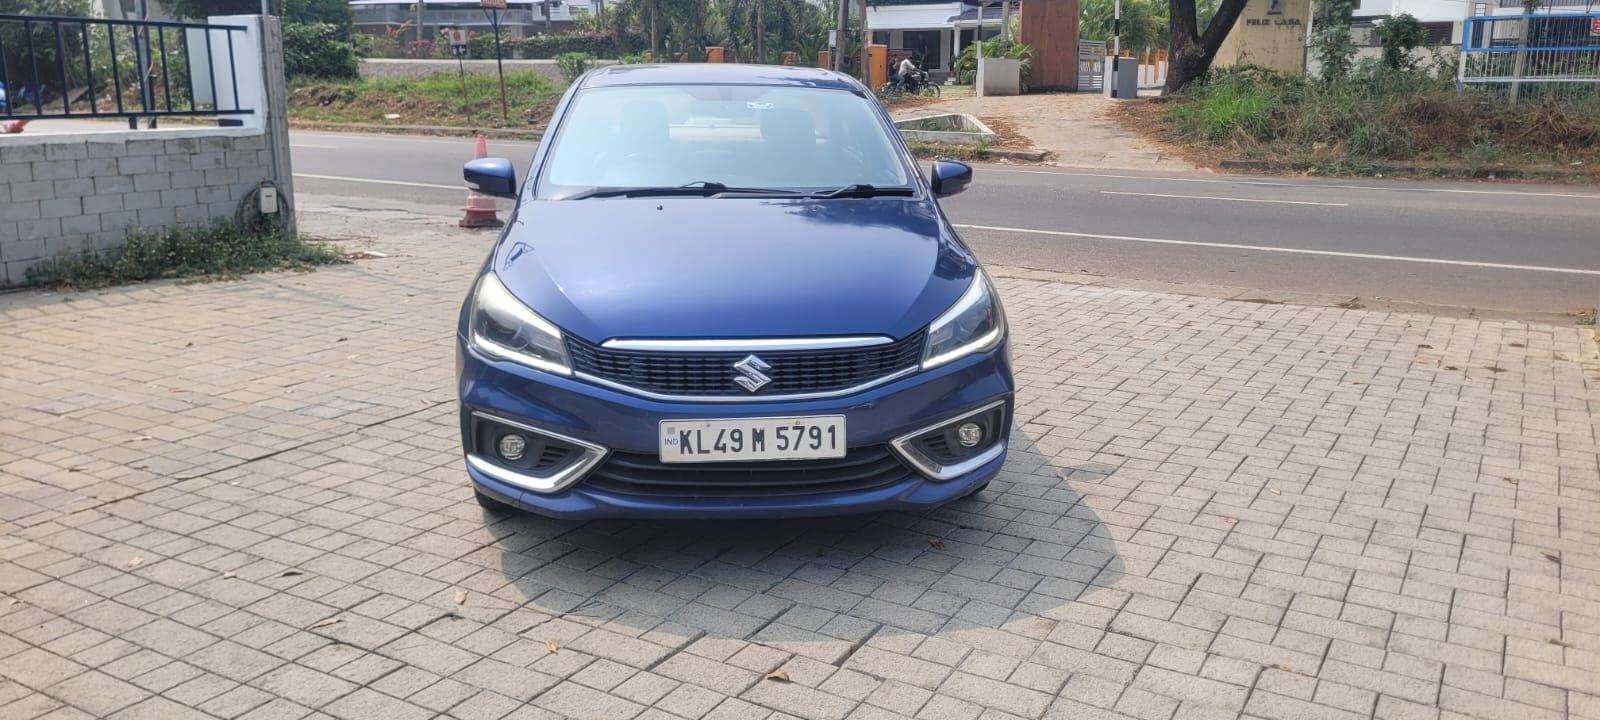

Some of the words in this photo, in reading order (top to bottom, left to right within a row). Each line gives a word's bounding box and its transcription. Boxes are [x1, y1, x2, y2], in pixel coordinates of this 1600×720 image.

[664, 438, 679, 446] IND
[679, 428, 743, 455] KL49
[751, 427, 765, 452] M
[775, 424, 836, 451] 5791
